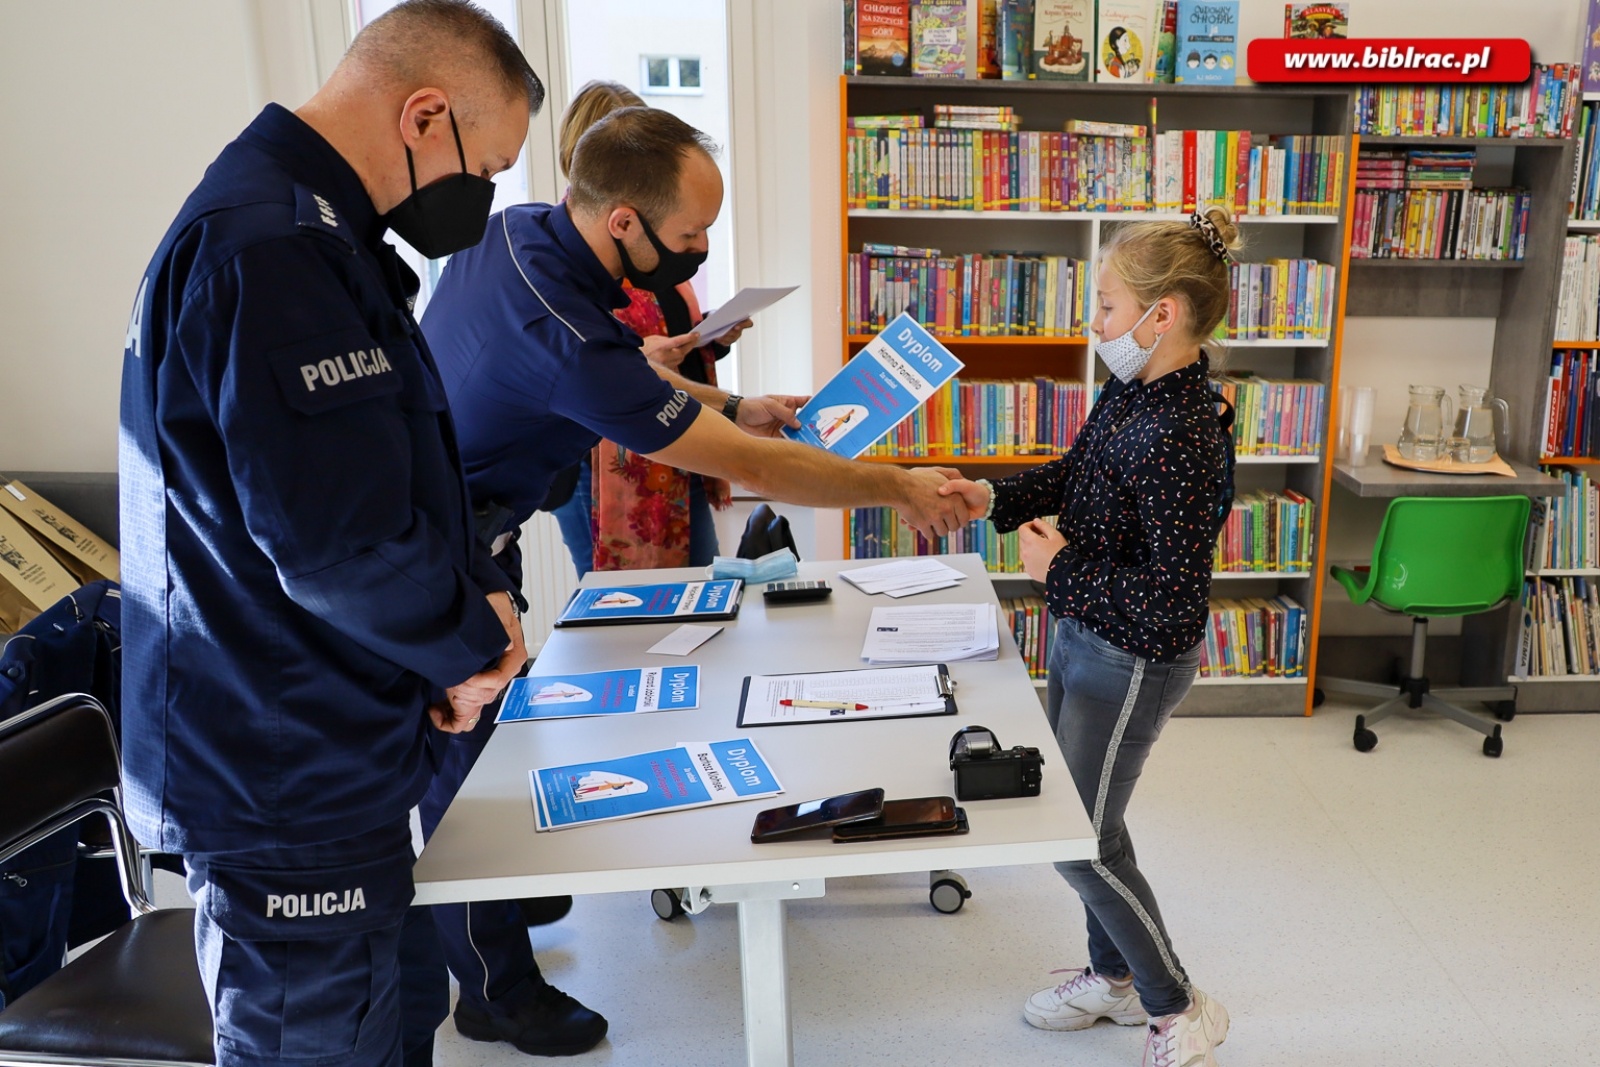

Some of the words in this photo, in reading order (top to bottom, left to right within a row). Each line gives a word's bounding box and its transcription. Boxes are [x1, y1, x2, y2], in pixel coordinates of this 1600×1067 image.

[863, 4, 903, 15] CHŁOPIEC
[872, 15, 904, 25] SZCZYCIE
[1305, 7, 1336, 15] KLASYKA
[872, 27, 895, 36] GÓRY
[125, 276, 149, 358] A
[877, 347, 899, 369] Hanna
[897, 327, 943, 373] Dyplom
[300, 347, 393, 392] POLICJA
[705, 585, 727, 608] Dyplom
[1521, 629, 1530, 667] ZIEMIA
[668, 672, 691, 703] Dyplom
[697, 753, 714, 772] Bartosz
[726, 748, 762, 787] Dyplom
[266, 887, 366, 918] POLICJA
